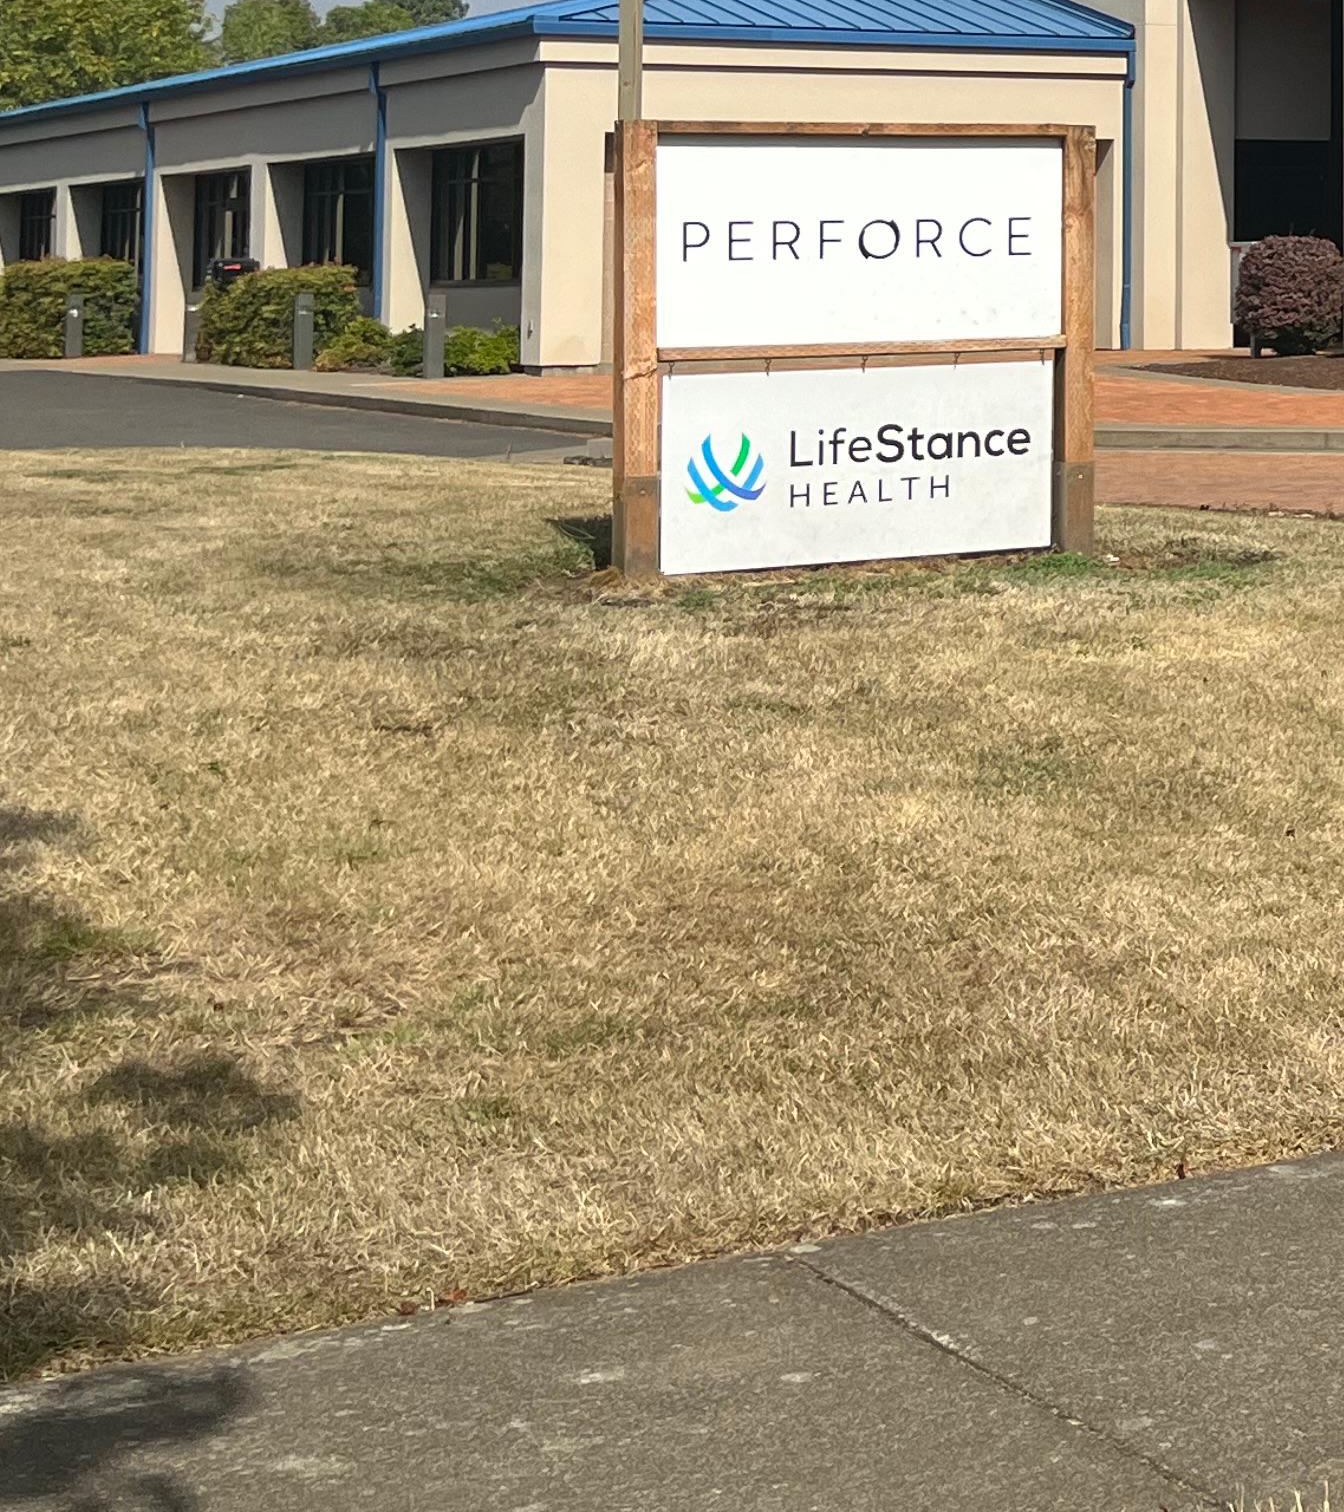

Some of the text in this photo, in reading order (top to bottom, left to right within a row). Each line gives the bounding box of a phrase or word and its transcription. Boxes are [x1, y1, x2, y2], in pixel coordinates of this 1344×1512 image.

[682, 217, 1032, 262] PERFORCE
[789, 423, 1031, 468] LifeStance
[789, 474, 951, 508] HEALTH
